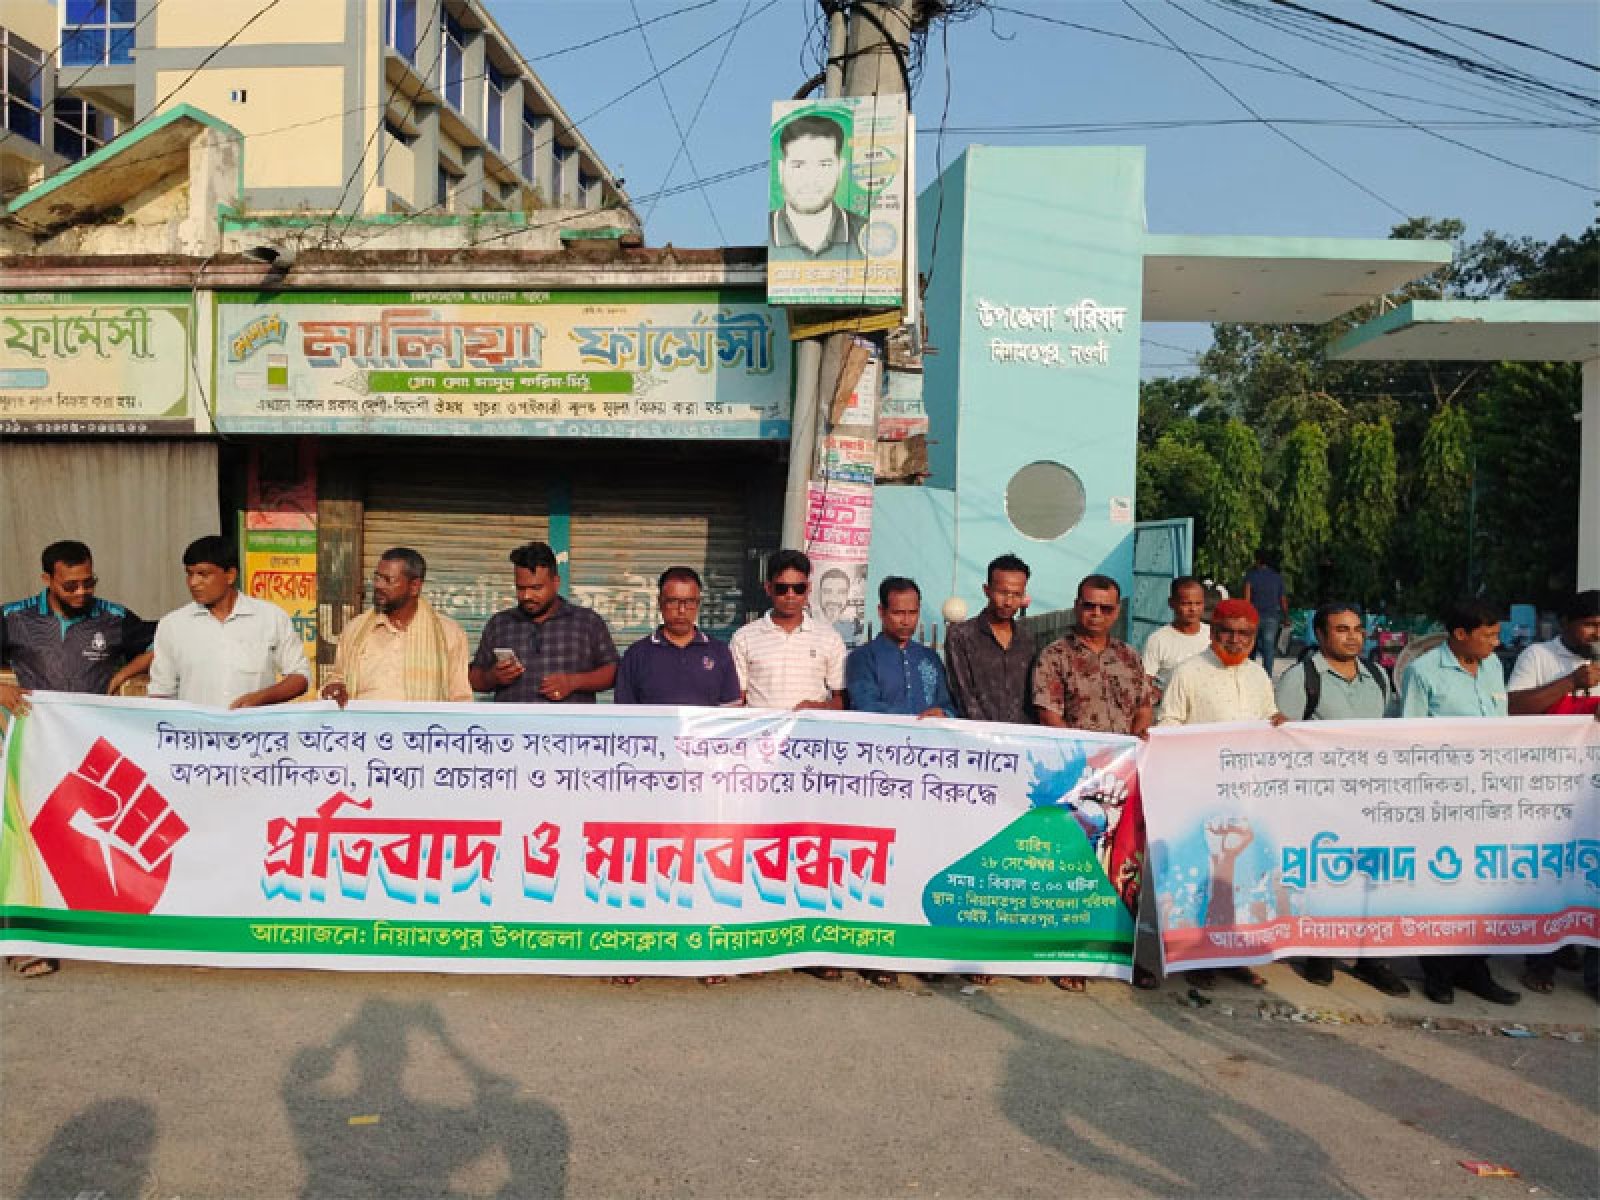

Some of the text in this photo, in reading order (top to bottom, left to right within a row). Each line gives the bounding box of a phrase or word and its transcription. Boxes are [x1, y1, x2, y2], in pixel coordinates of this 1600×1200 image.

[2, 308, 153, 360] ফার্মেসী
[976, 299, 1057, 331] উপজেলা
[568, 308, 775, 374] ফার্মেসী
[157, 721, 289, 758] নিয়ামতপুরে
[297, 724, 367, 753] অবৈধ
[375, 731, 393, 752] ও
[402, 723, 515, 755] অনিবন্ধিত
[522, 731, 666, 761] সংবাদমাধ্যম,
[857, 736, 961, 769] সংগঠনের
[967, 750, 1020, 774] নামে
[1219, 747, 1314, 772] নিয়ামতপুরে
[1320, 747, 1369, 768] অবৈধ
[1375, 751, 1389, 766] ও
[1392, 743, 1475, 767] অনিবন্ধিত
[1479, 747, 1583, 767] সংবাদমাধ্যম,
[170, 757, 999, 805] অপসাংবাদিকতা, মিথ্যা প্রচারণা ও সাংবাদিকতার পরিচয়ে চাঁদাবাজির বিরুদ্ধে
[1216, 776, 1289, 800] সংগঠনের
[1294, 778, 1335, 797] নামে
[1340, 771, 1477, 797] অপসাংবাদিকতা,
[1482, 771, 1525, 793] মিথ্যা
[1361, 798, 1576, 823] পরিচয়ে চাঁদাবাজির বিরুদ্ধে
[262, 791, 897, 908] প্রতিবাদ ও মানববন্ধন
[1281, 831, 1417, 889] প্রতিবাদ
[1428, 845, 1463, 883] ও
[373, 919, 484, 951] নিয়ামতপুর
[490, 925, 583, 949] উপজেলা
[590, 927, 679, 952] প্রেসক্লাব
[686, 931, 702, 950] ও
[709, 924, 806, 950] নিয়ামতপুর
[812, 924, 896, 948] প্রেসক্লাব
[1297, 916, 1393, 943] নিয়ামতপুর
[1401, 916, 1477, 939] উপজেলা
[1485, 919, 1537, 938] মডেল
